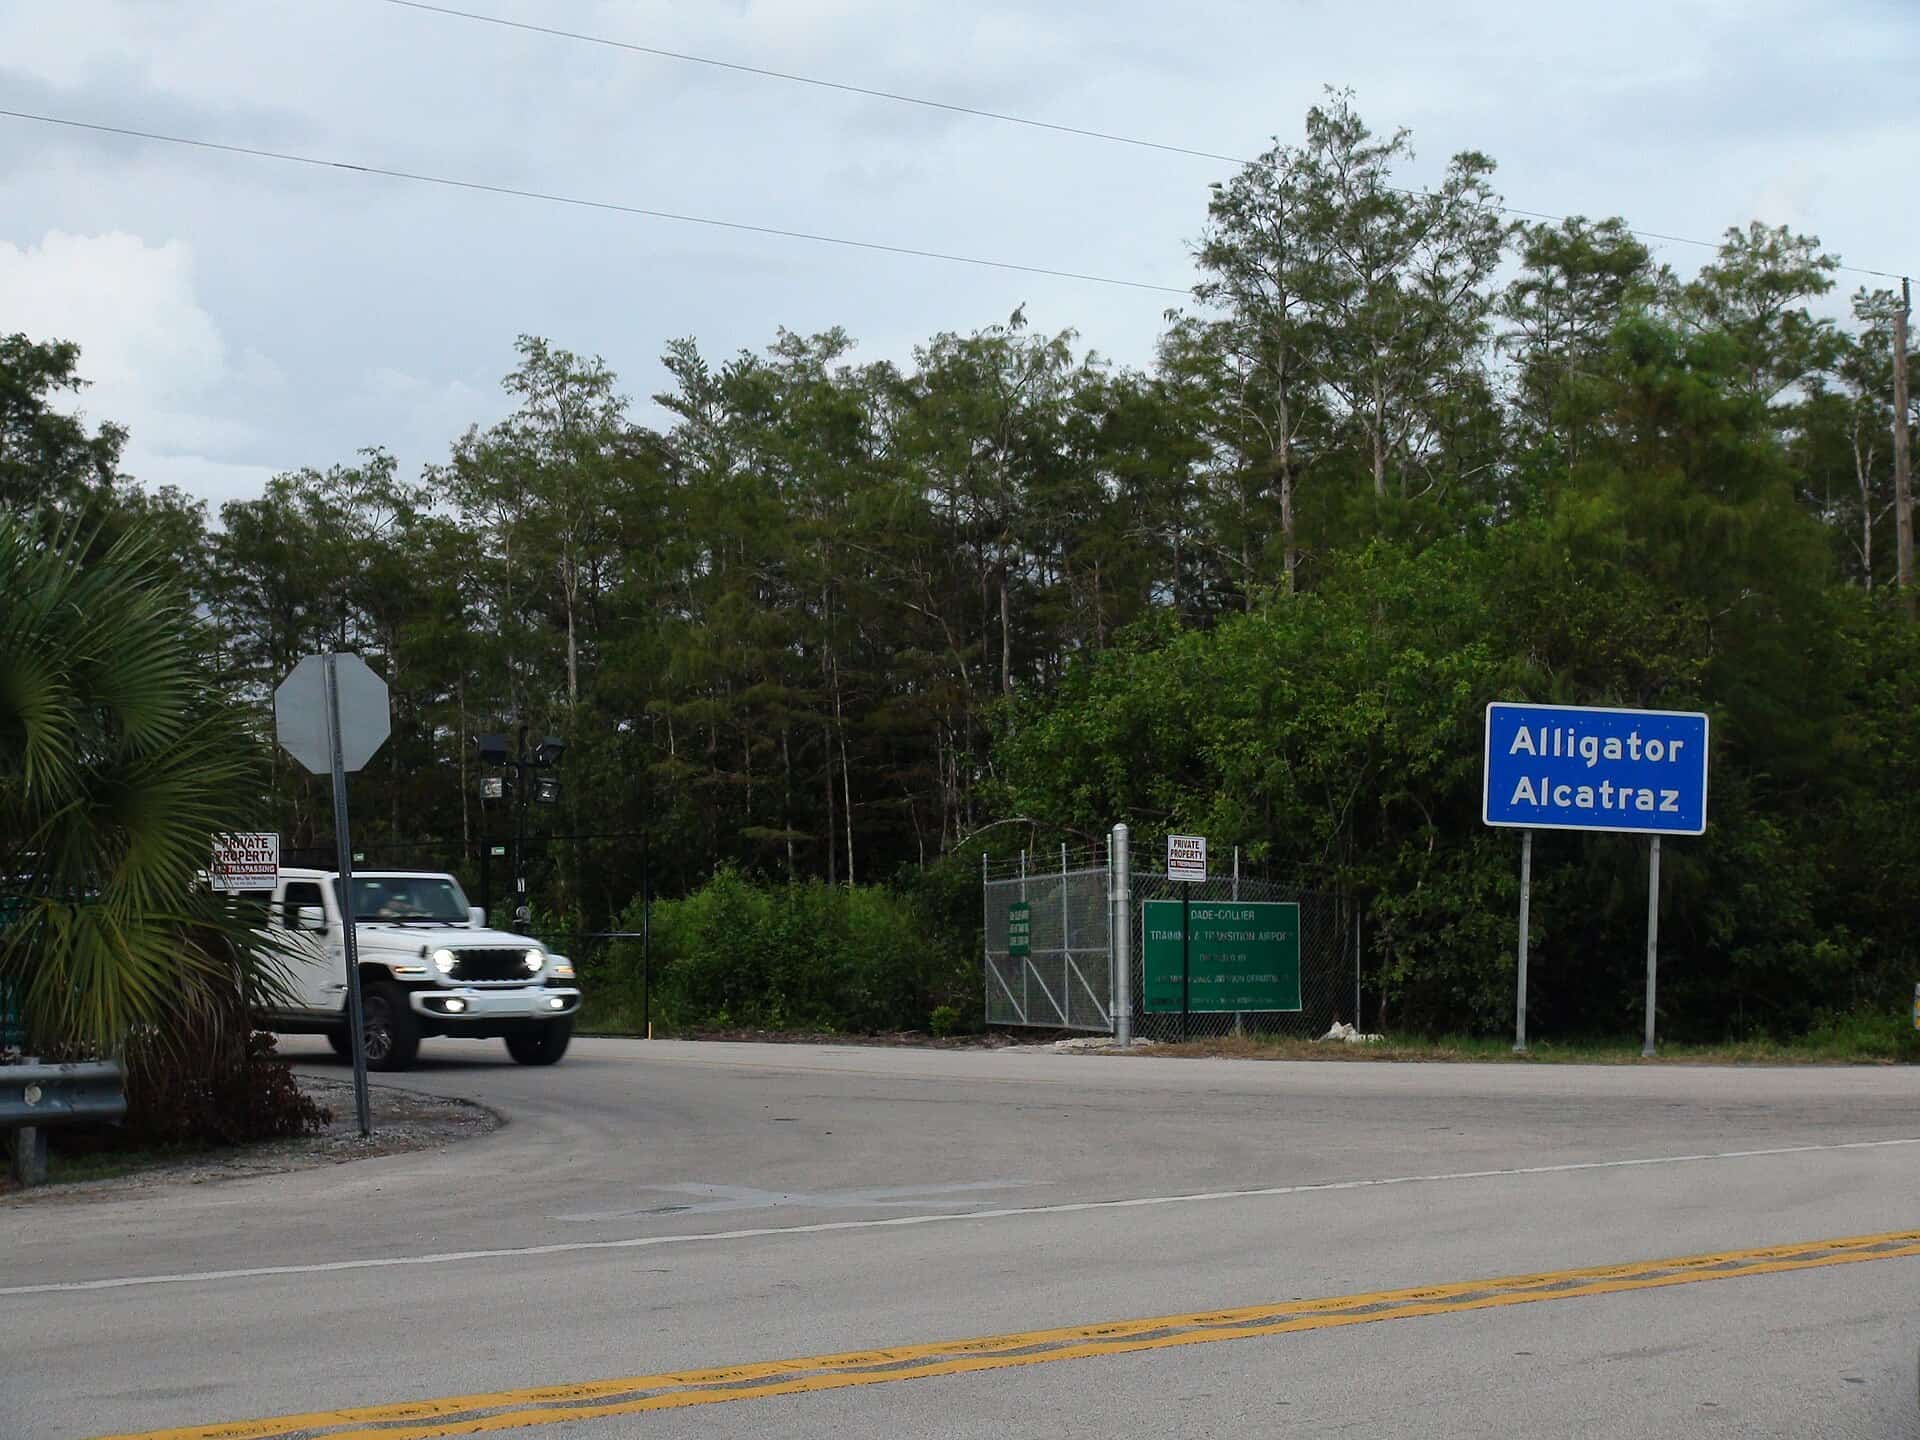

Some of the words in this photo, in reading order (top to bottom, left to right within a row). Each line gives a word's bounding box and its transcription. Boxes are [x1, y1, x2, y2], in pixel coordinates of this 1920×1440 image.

[1509, 726, 1684, 768] Alligator
[1510, 776, 1680, 812] Alcatraz
[222, 837, 268, 849] PRIVATE
[1173, 839, 1200, 849] PRIVATE
[215, 850, 274, 862] PROPERTY
[1170, 849, 1203, 859] PROPERTY
[1190, 910, 1255, 921] DADE-COLLIER
[1150, 930, 1191, 941] TRAININ
[1258, 931, 1293, 942] AIRPOR
